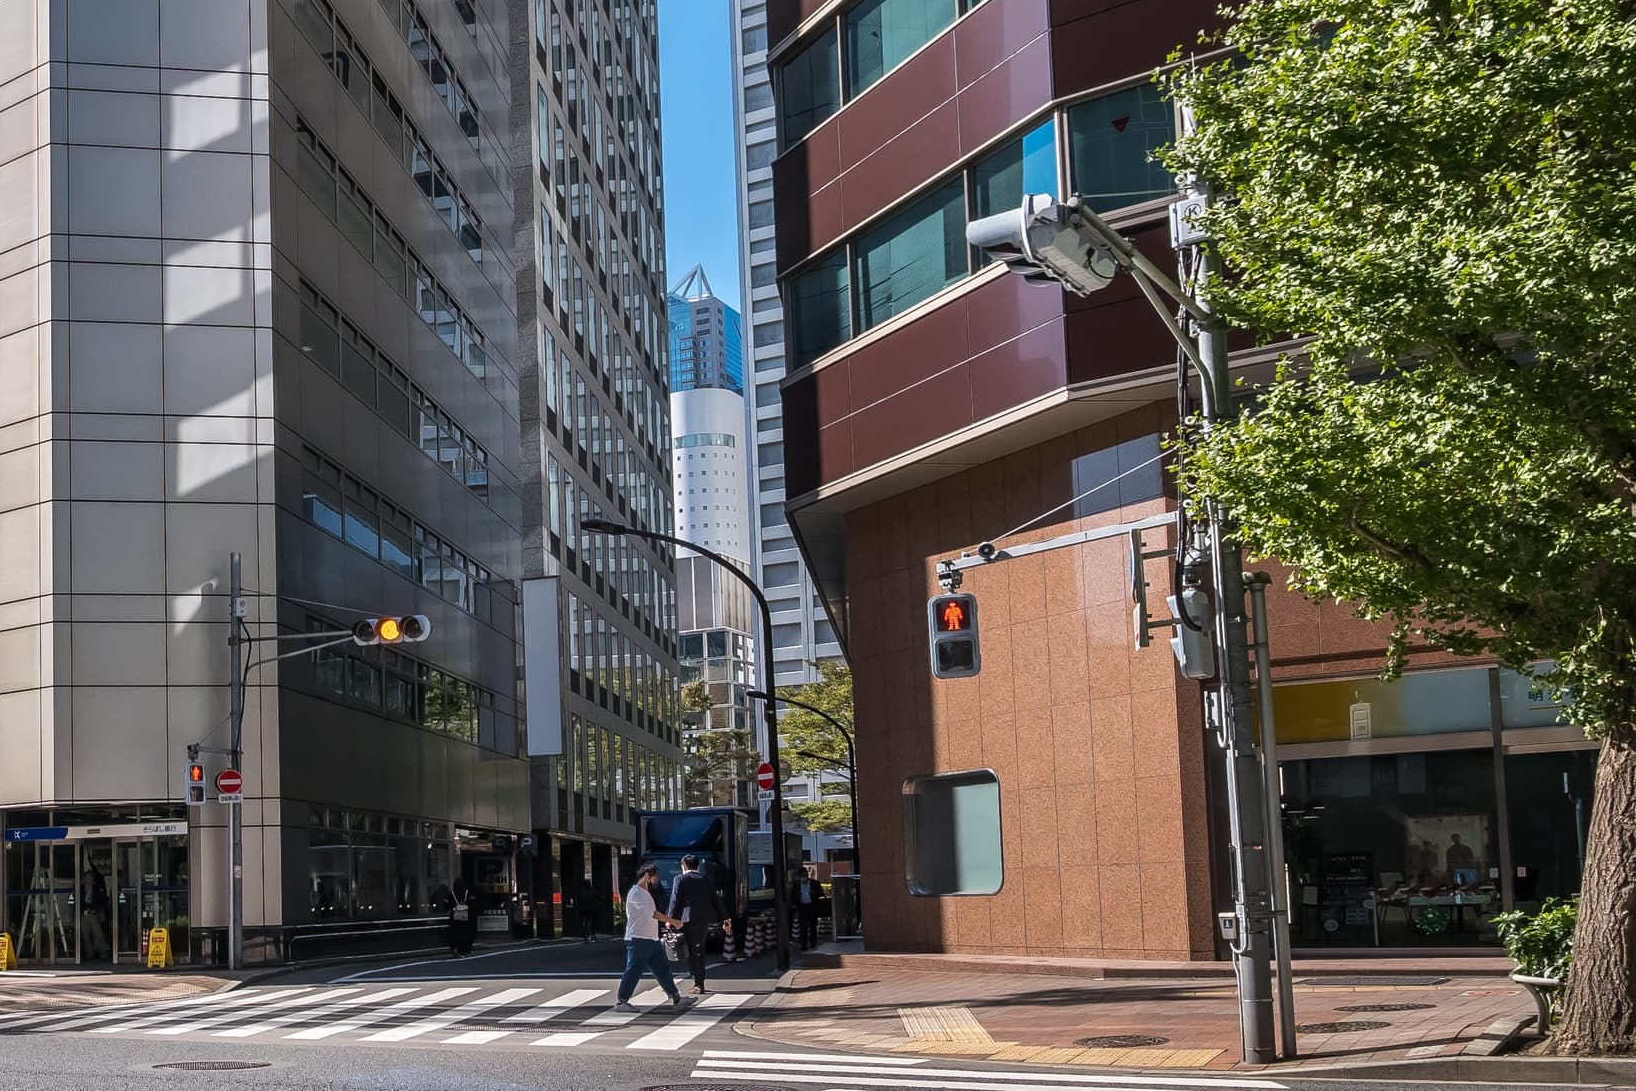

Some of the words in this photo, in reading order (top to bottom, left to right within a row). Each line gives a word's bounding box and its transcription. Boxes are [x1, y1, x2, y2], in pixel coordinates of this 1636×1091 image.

[143, 824, 176, 834] きらぼし銀行
[521, 837, 532, 848] P
